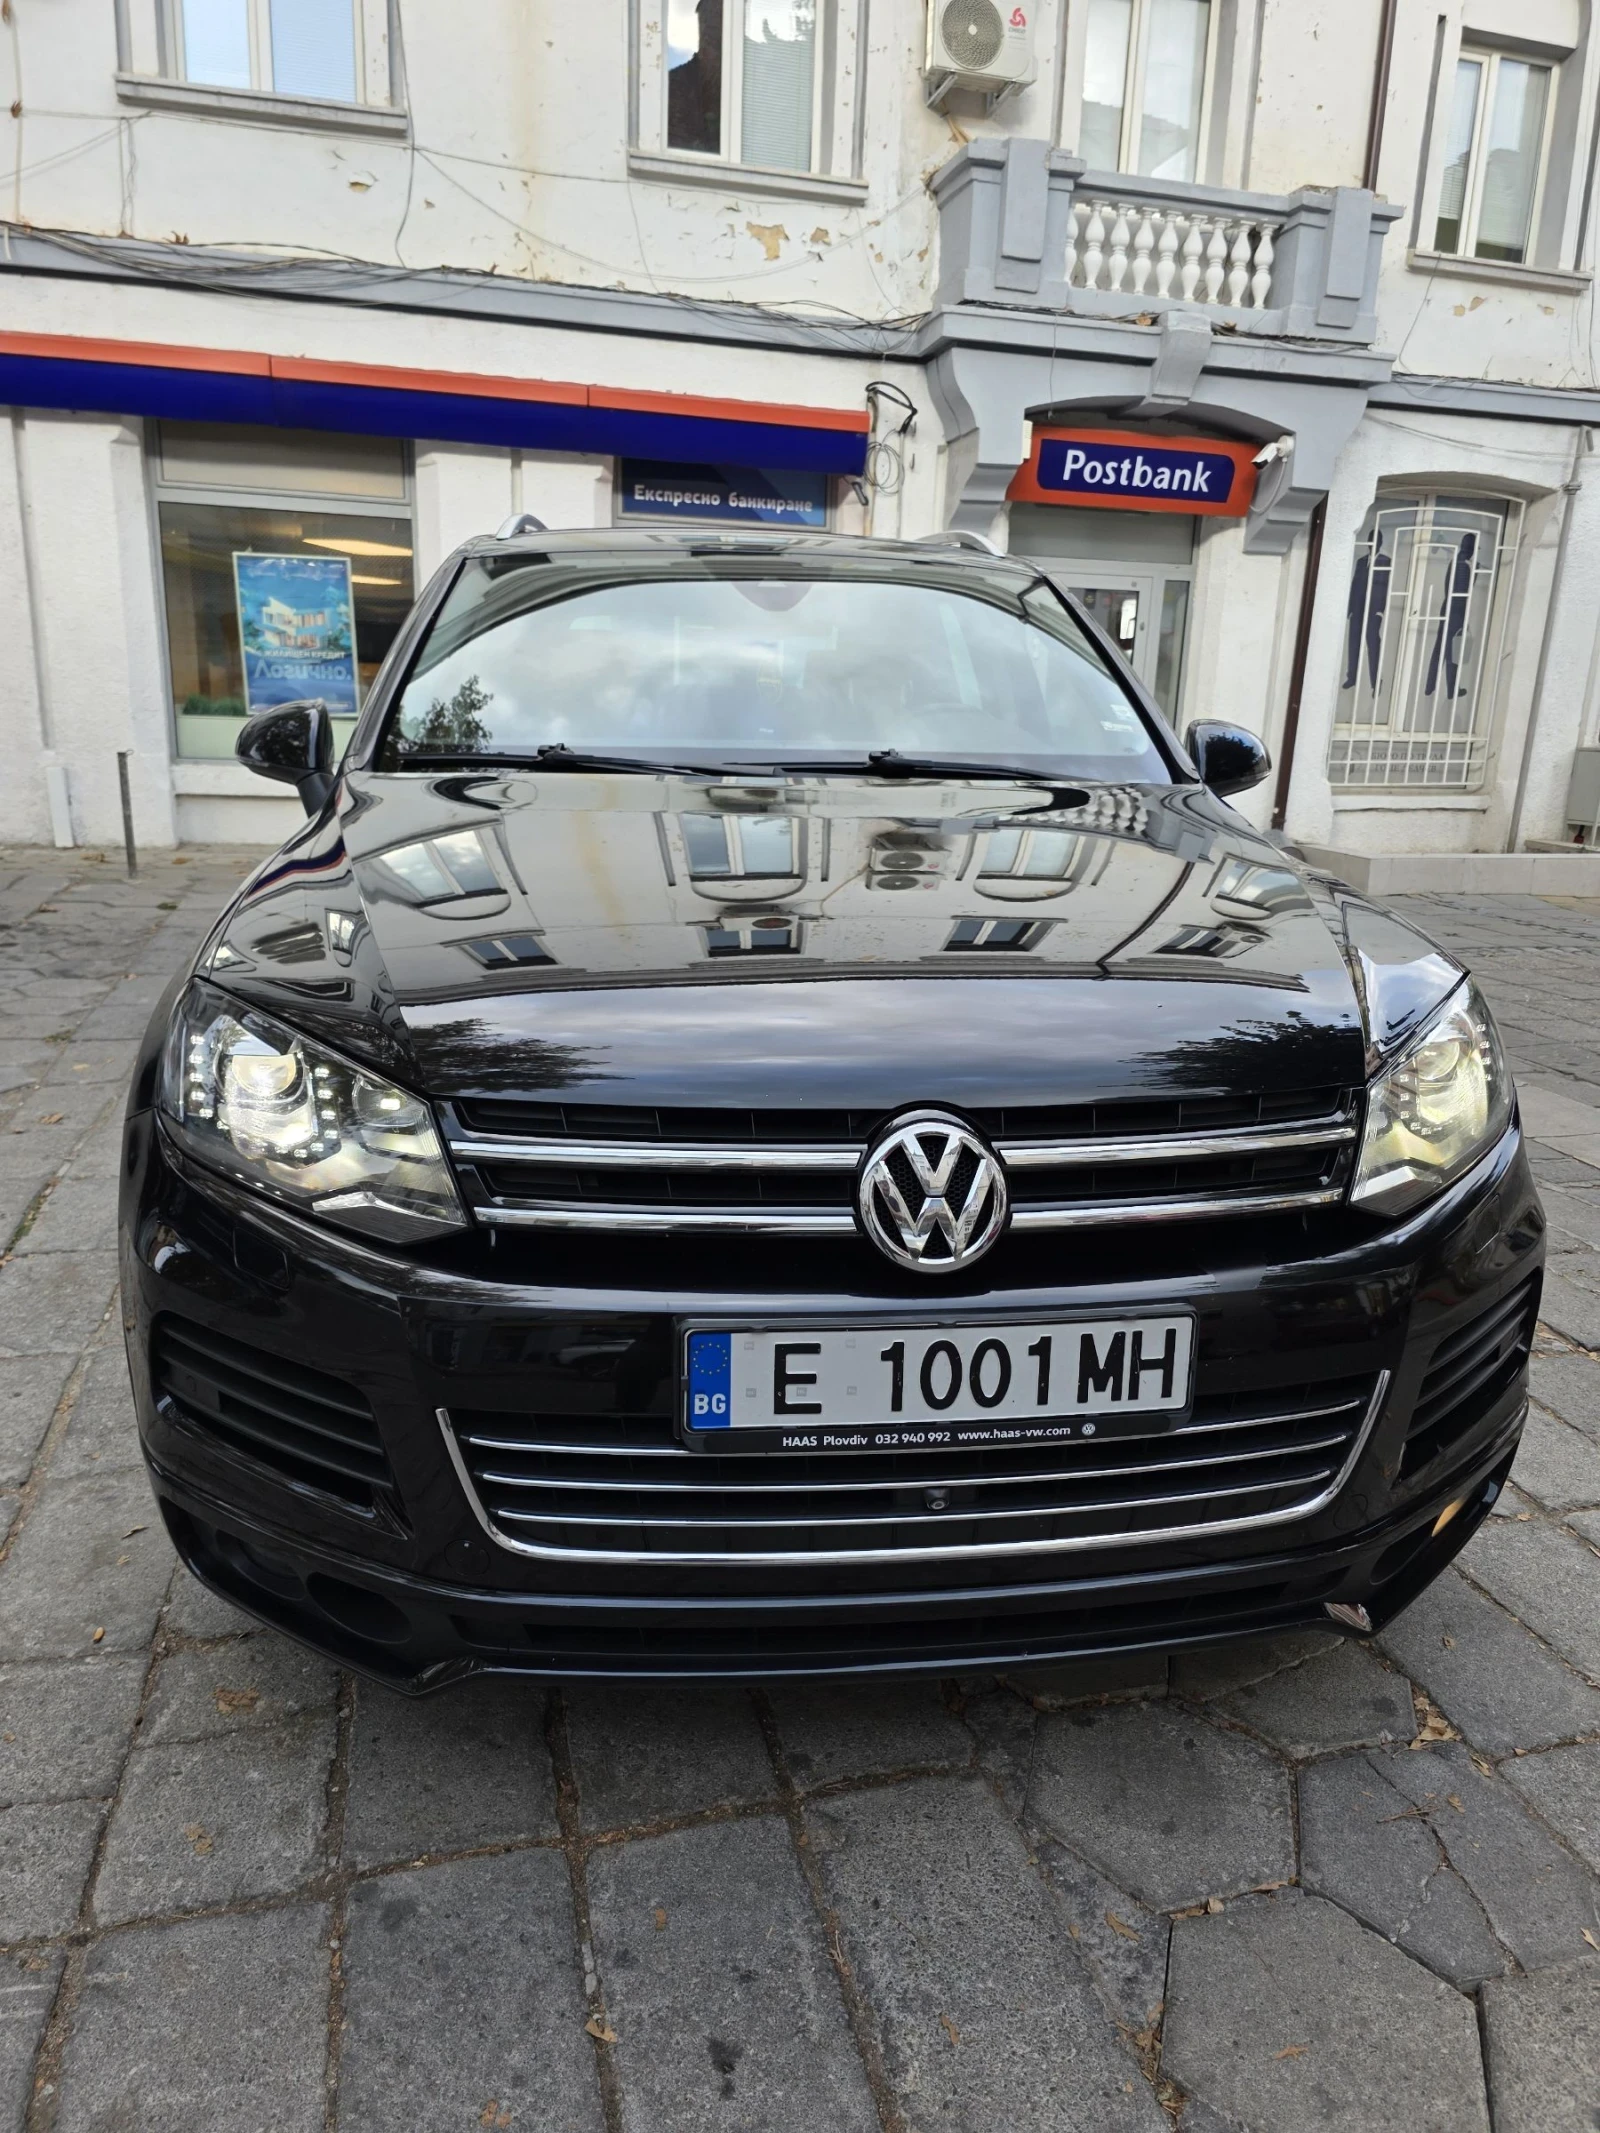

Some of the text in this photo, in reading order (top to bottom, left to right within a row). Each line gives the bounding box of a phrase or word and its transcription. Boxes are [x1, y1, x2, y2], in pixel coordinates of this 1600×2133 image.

[1062, 448, 1212, 493] Postbank
[634, 484, 813, 514] Експресно банкиране
[1371, 752, 1398, 761] БЮО
[859, 1109, 1007, 1273] VW
[773, 1328, 1177, 1415] E 1001 MH
[693, 1393, 727, 1416] BG
[782, 1436, 818, 1447] HAAS
[823, 1434, 868, 1446] Plovdiv
[875, 1433, 899, 1444] 032
[901, 1432, 926, 1443] 940
[927, 1431, 951, 1442] 992
[957, 1426, 1071, 1440] www.haas-vw.com
